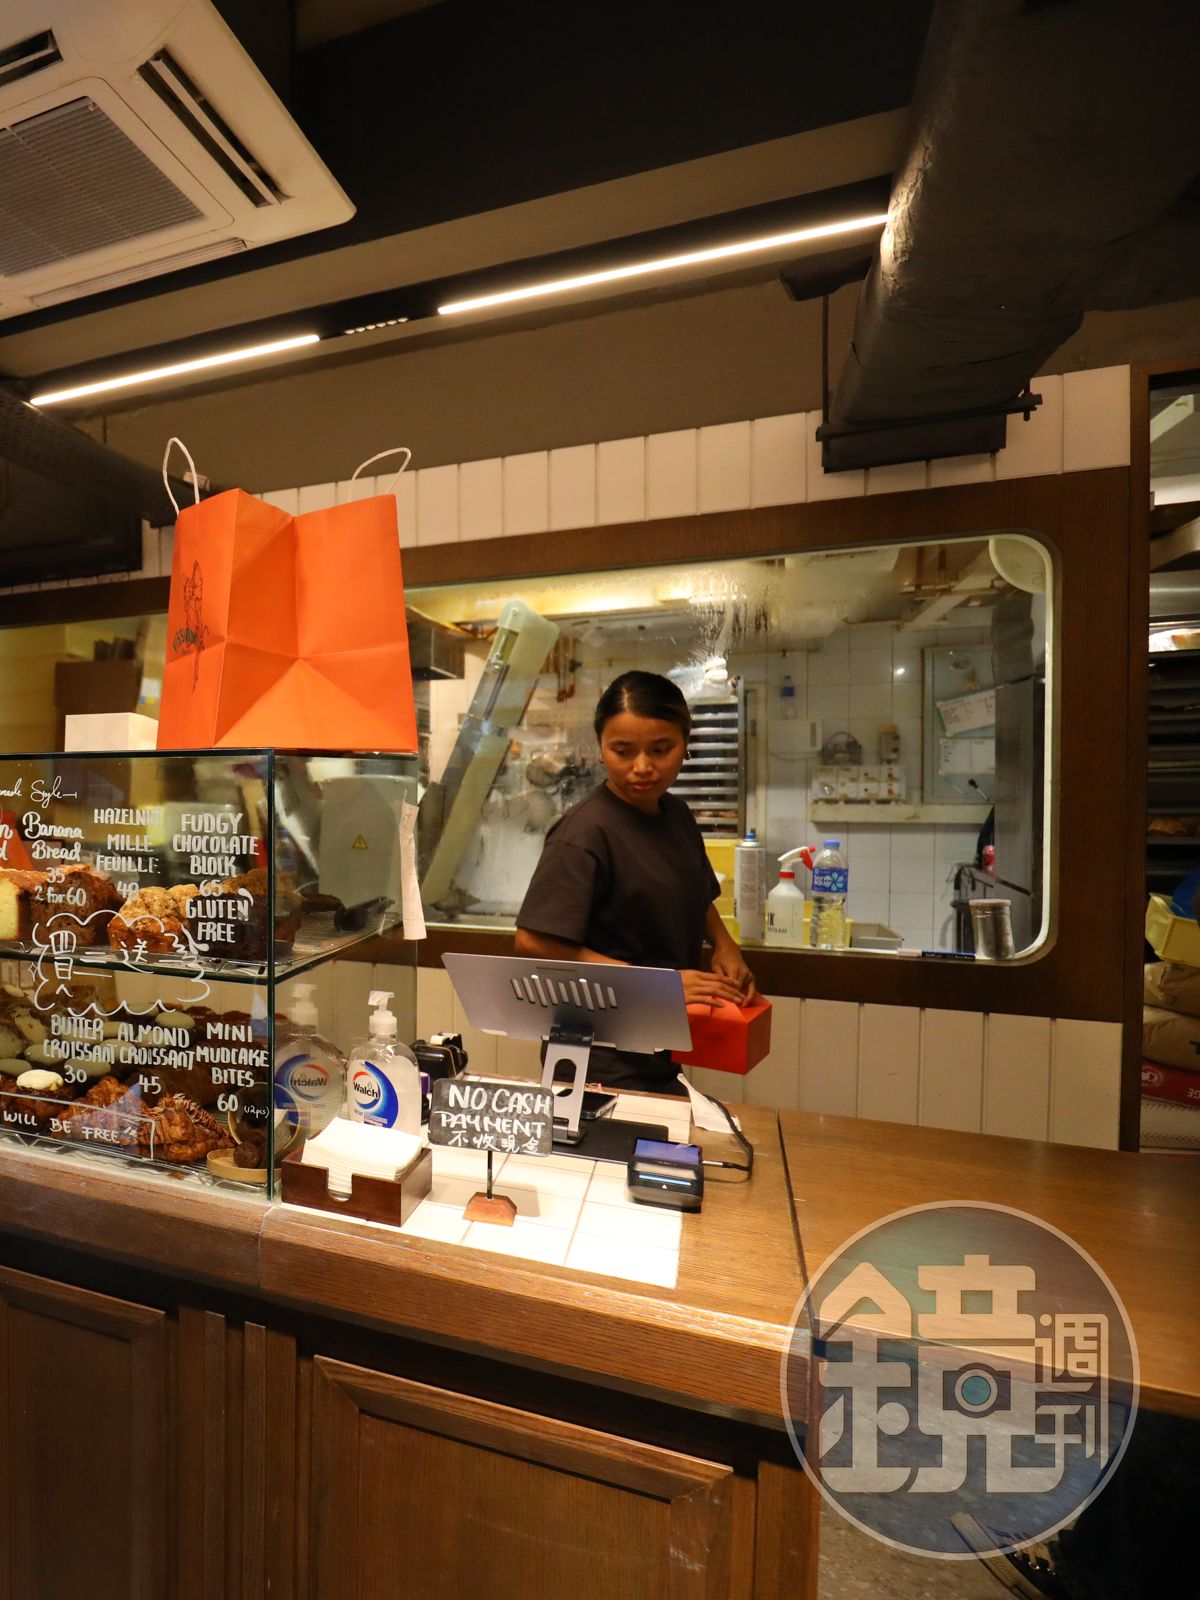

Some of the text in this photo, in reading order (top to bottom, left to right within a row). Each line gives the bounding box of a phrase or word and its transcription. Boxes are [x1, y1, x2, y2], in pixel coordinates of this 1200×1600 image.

[22, 811, 84, 839] Banana
[93, 808, 161, 825] HAZELNUT
[181, 812, 243, 834] FUDGY
[31, 840, 81, 861] Bread
[107, 834, 153, 852] MILLE
[172, 835, 260, 855] CHOCOLATE
[46, 868, 65, 883] 35
[190, 855, 237, 877] BLOCK
[35, 886, 87, 905] 2 for 60
[200, 879, 224, 897] 65
[186, 899, 249, 921] GLUTEN
[198, 921, 236, 943] FREE
[51, 1014, 104, 1041] BUTTER
[117, 1022, 190, 1049] ALMOND
[206, 1022, 253, 1042] MINI
[42, 1039, 115, 1064] CROISSANT
[119, 1046, 196, 1071] CROISSANT
[196, 1045, 270, 1068] MUDCAKE
[64, 1064, 88, 1084] 30
[139, 1074, 161, 1095] 45
[211, 1067, 255, 1087] BITES
[352, 1082, 378, 1099] Walch
[448, 1084, 551, 1117] NO CASH
[217, 1093, 239, 1112] 60
[3, 1111, 38, 1126] WILL
[50, 1118, 71, 1133] BE
[434, 1110, 546, 1139] PAYMENT
[448, 1130, 545, 1156] 不收現金
